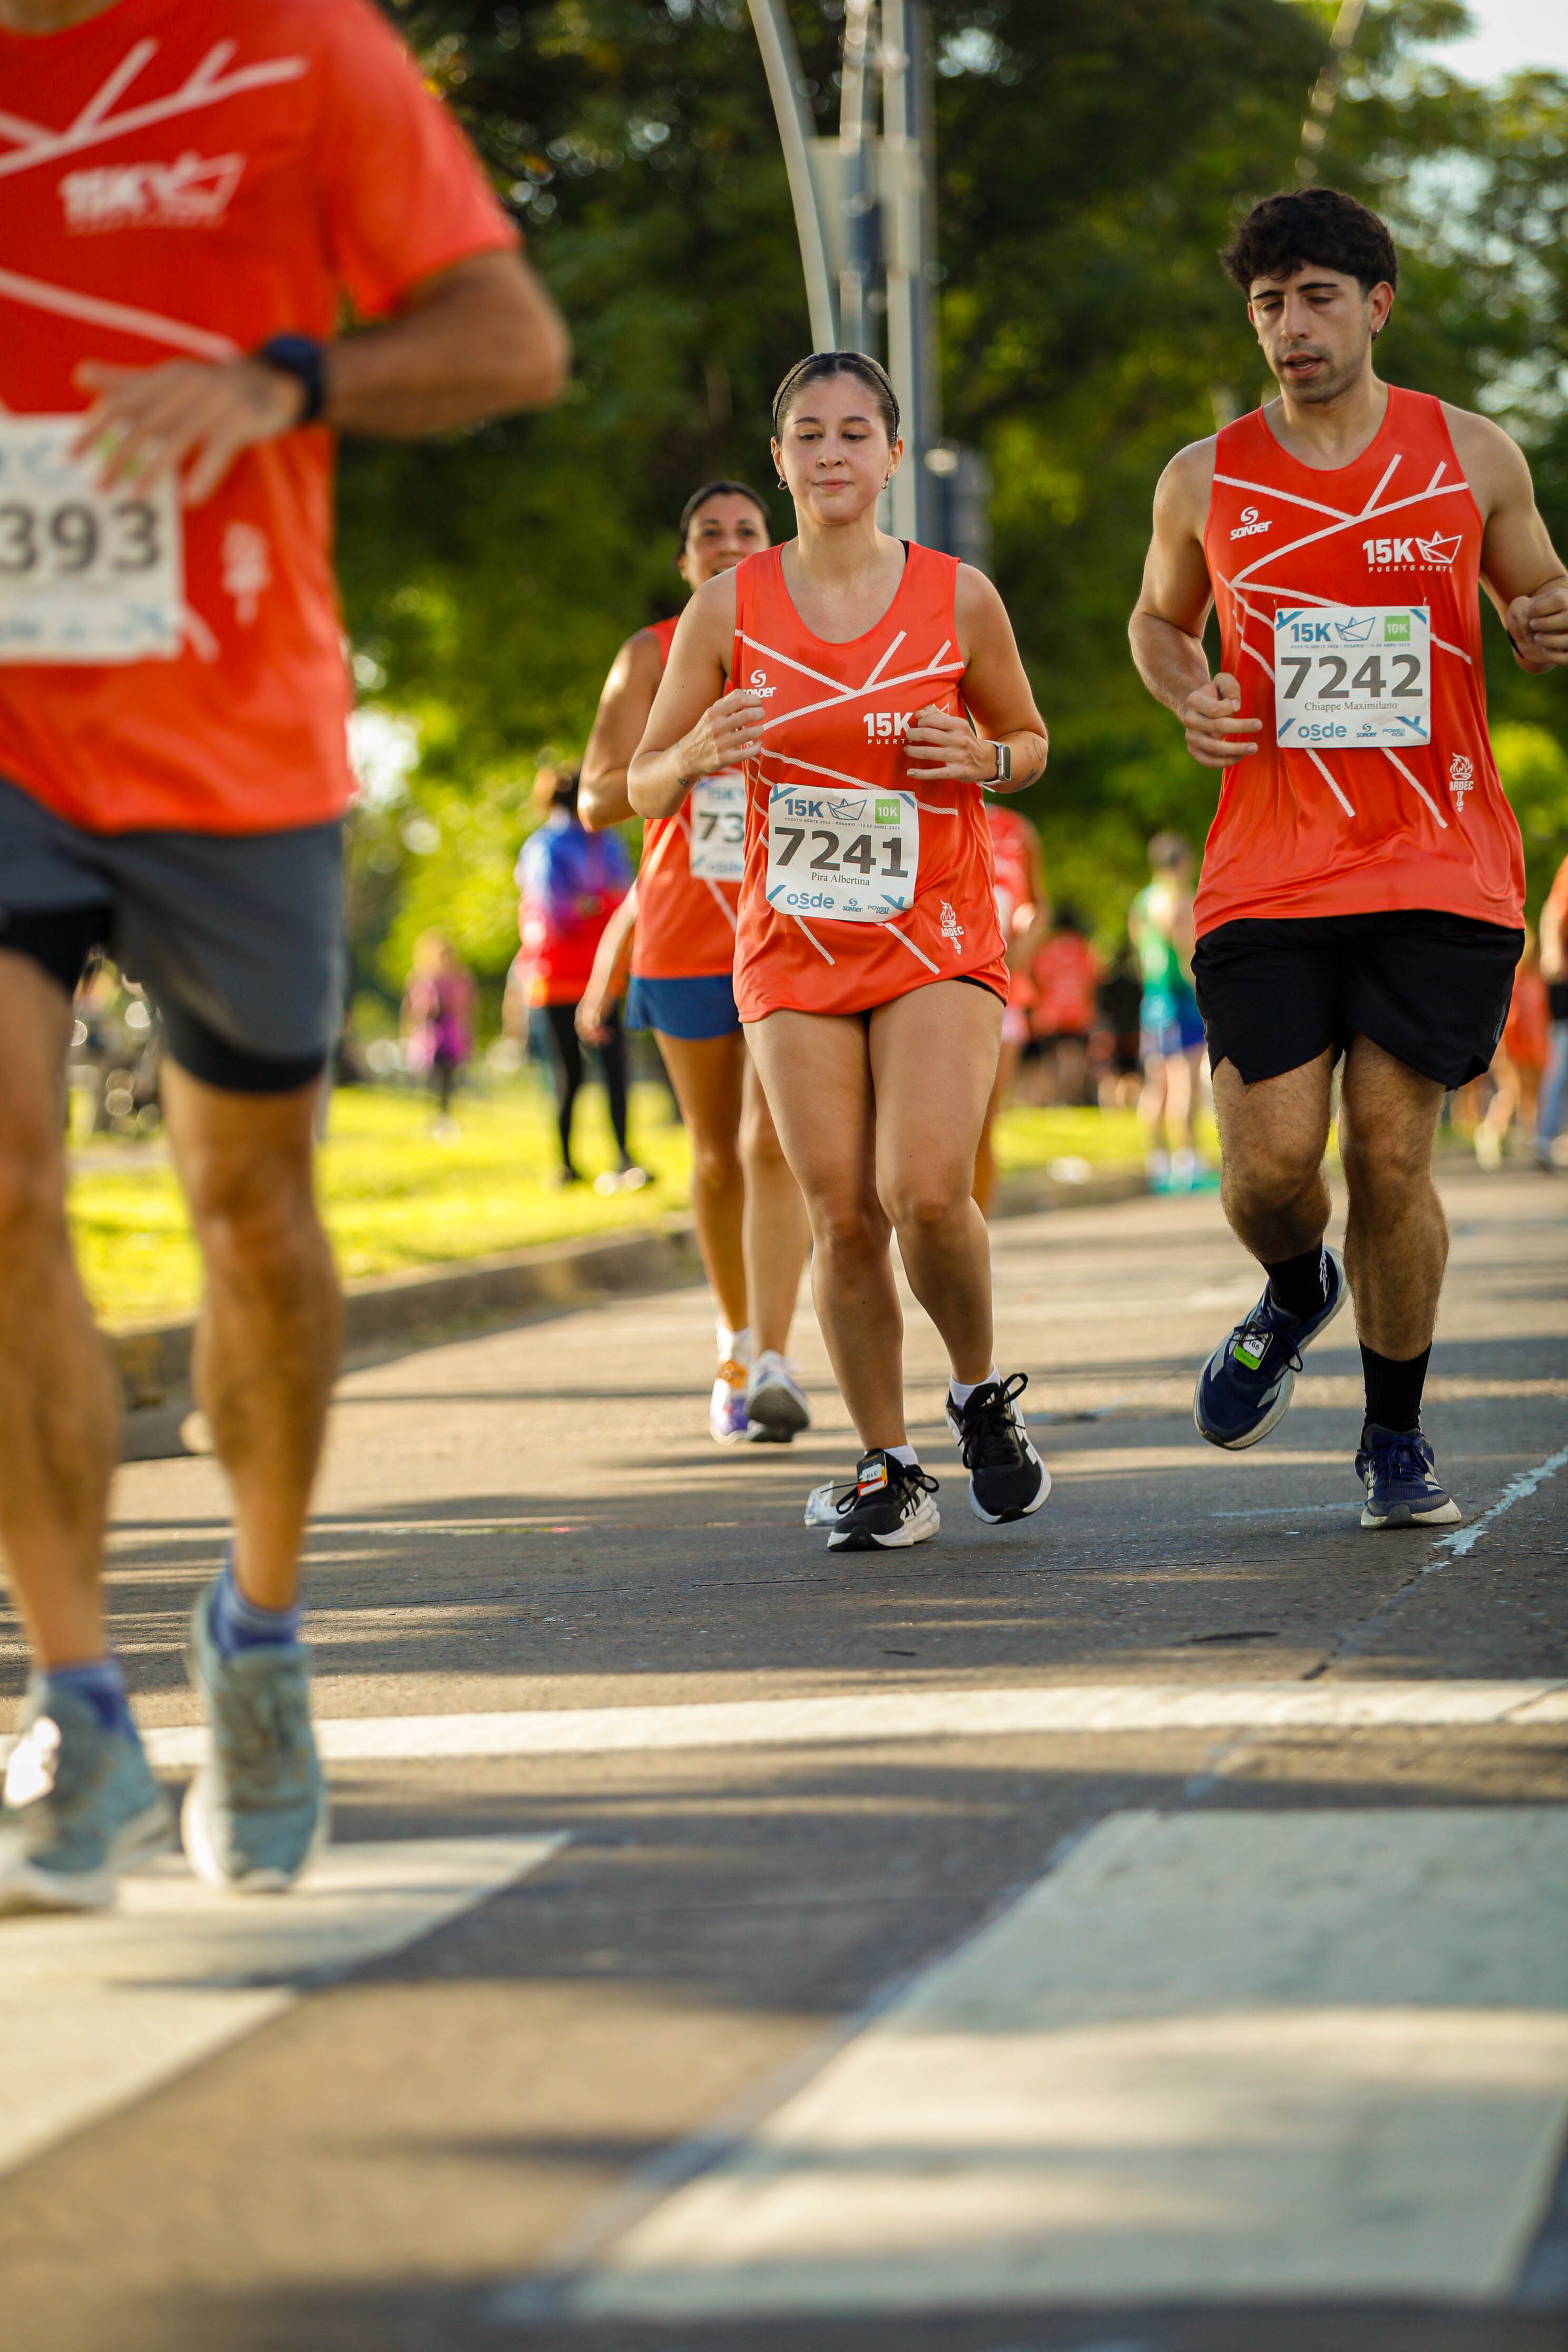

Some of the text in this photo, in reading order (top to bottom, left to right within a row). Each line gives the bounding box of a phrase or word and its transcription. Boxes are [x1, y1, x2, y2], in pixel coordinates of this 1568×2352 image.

[0, 498, 161, 575] 393
[1363, 538, 1415, 564] 15K
[1419, 565, 1454, 573] NORTE
[1290, 623, 1332, 642] 15K
[1386, 623, 1408, 634] 10K
[1281, 654, 1423, 699] 7242
[1304, 701, 1398, 712] Chiappe Maximilano
[863, 712, 914, 737] 15K
[1298, 722, 1347, 739] osde
[1449, 780, 1474, 791] ARDEC
[785, 798, 824, 818] 15K
[878, 806, 898, 817] 10K
[775, 827, 908, 878] 7241
[811, 871, 870, 886] Pira Albertina
[787, 892, 835, 908] osde
[940, 926, 964, 937] ARDEC
